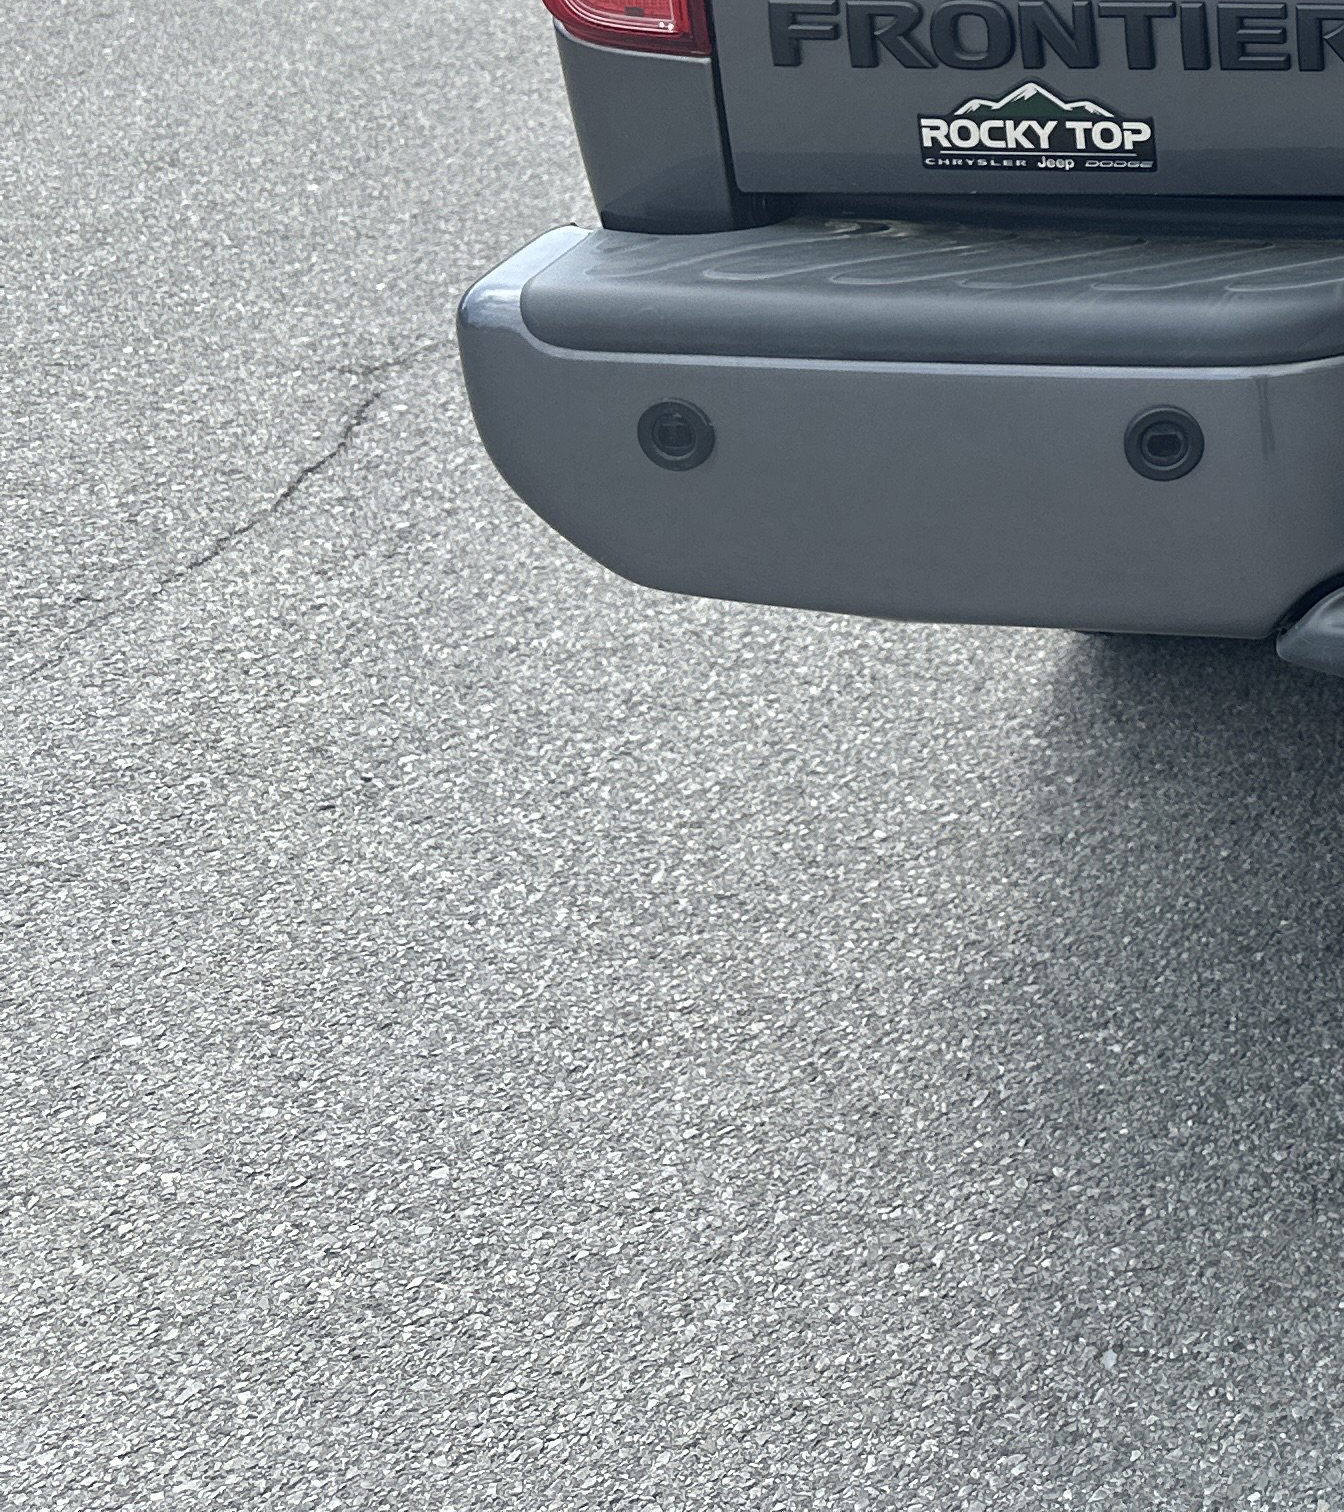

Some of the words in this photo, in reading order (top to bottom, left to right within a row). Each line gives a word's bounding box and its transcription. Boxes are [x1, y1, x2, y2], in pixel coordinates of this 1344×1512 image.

[920, 118, 1058, 149] ROCKY
[1065, 121, 1151, 150] TOP
[924, 158, 1027, 166] CHRYSLER
[1037, 156, 1075, 170] Jeep
[1085, 160, 1153, 168] DODGE
